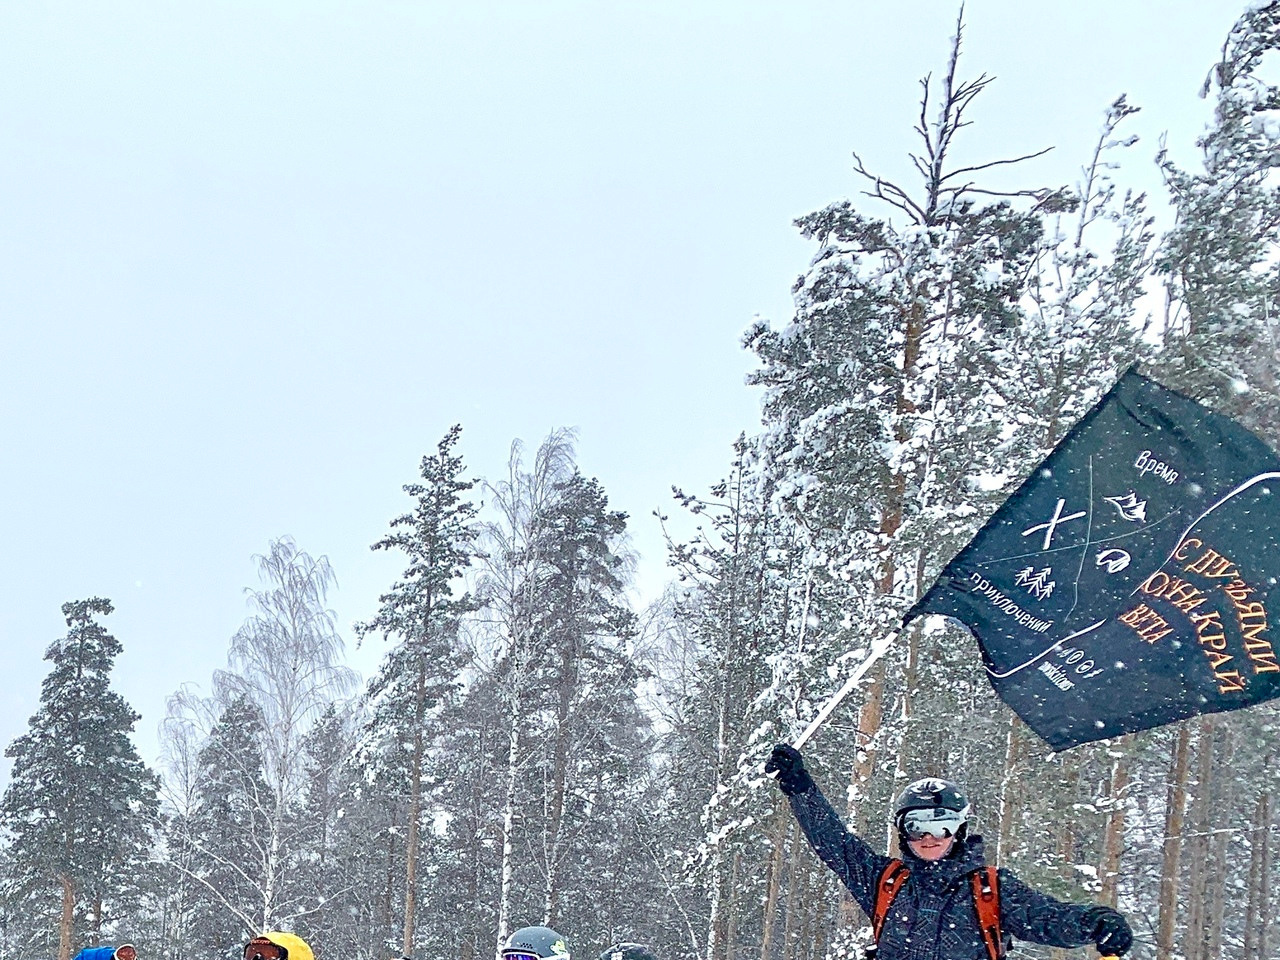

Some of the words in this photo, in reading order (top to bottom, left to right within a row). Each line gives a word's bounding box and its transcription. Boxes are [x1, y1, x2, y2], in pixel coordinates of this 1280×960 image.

[1134, 449, 1179, 485] Время
[1174, 538, 1203, 561] С
[1117, 603, 1174, 645] ВЕТА
[1184, 548, 1280, 675] ДУЬЯМИ
[1189, 610, 1246, 694] КРАЙ
